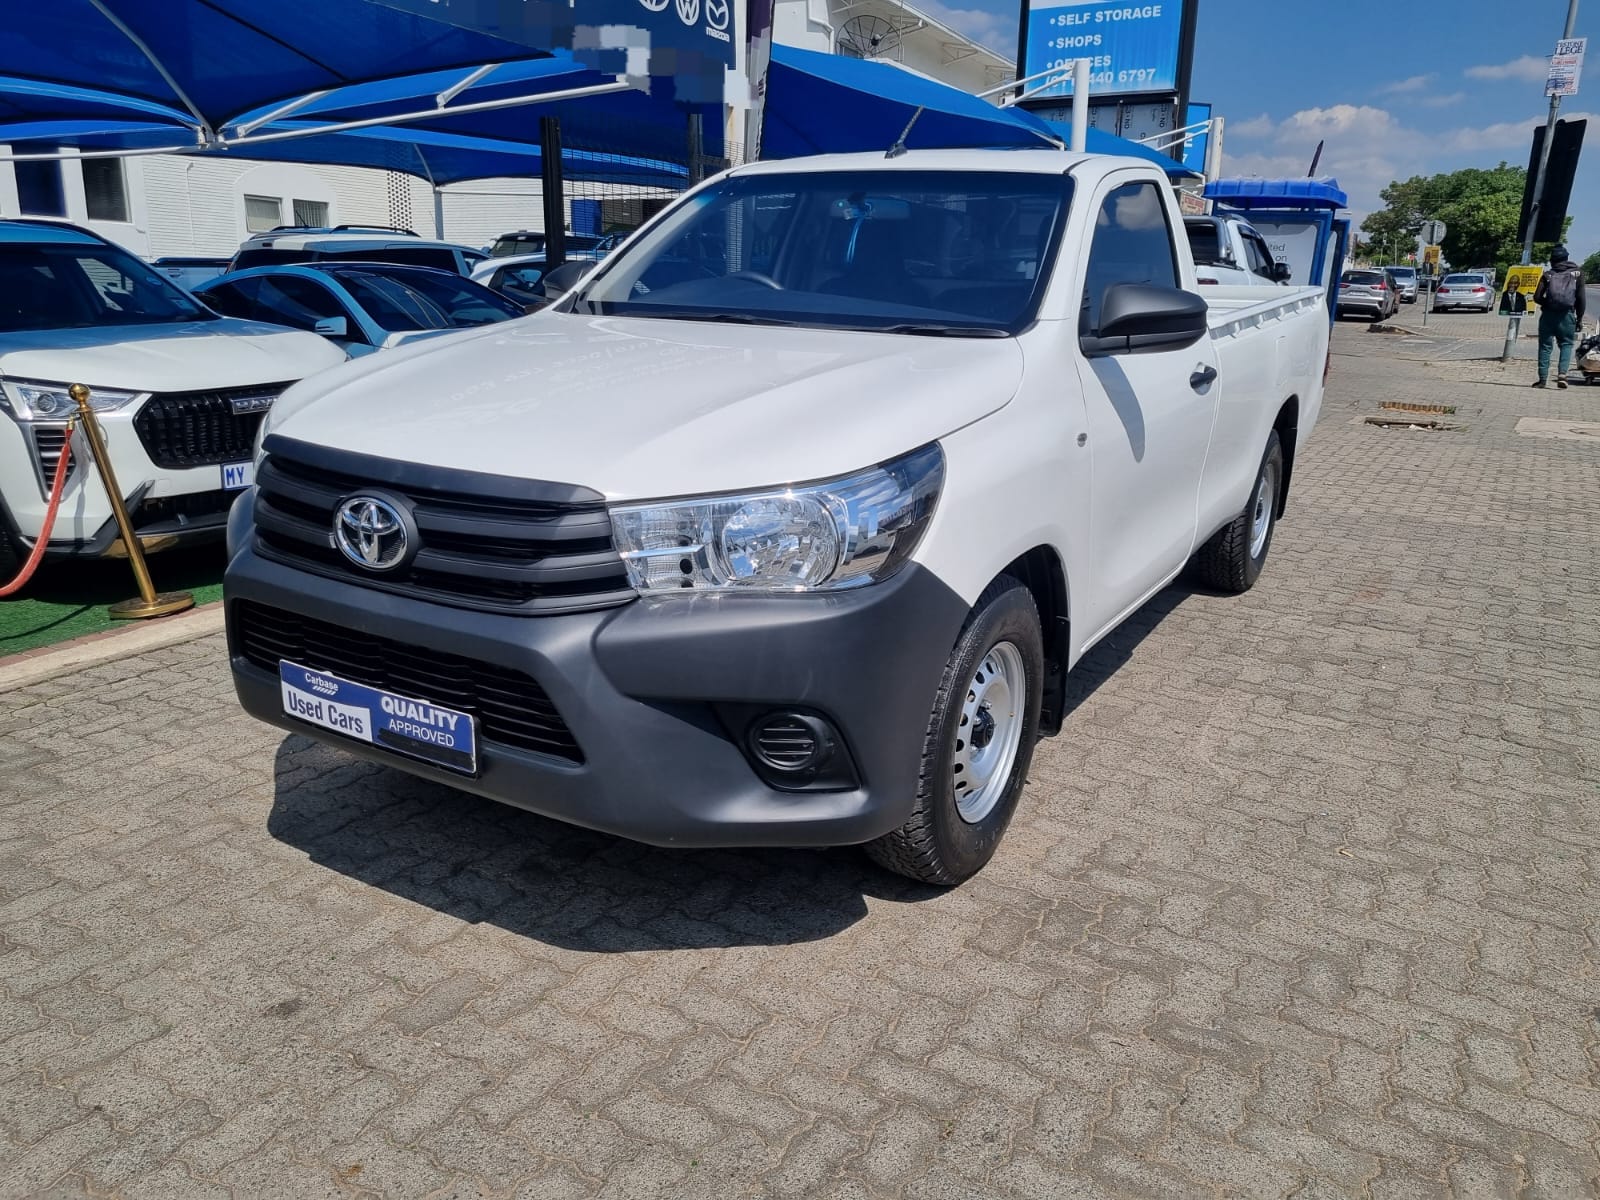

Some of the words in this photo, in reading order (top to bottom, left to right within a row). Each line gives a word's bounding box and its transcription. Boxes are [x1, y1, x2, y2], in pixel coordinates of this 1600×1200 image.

[1057, 12, 1091, 26] SELF
[1095, 5, 1162, 23] STORAGE
[1056, 34, 1102, 48] SHOPS
[1119, 68, 1156, 83] 6797
[305, 672, 339, 692] Carbase
[288, 690, 323, 721] Used
[328, 706, 364, 734] Cars
[381, 696, 460, 731] QUALITY
[389, 718, 455, 748] APPROVED
